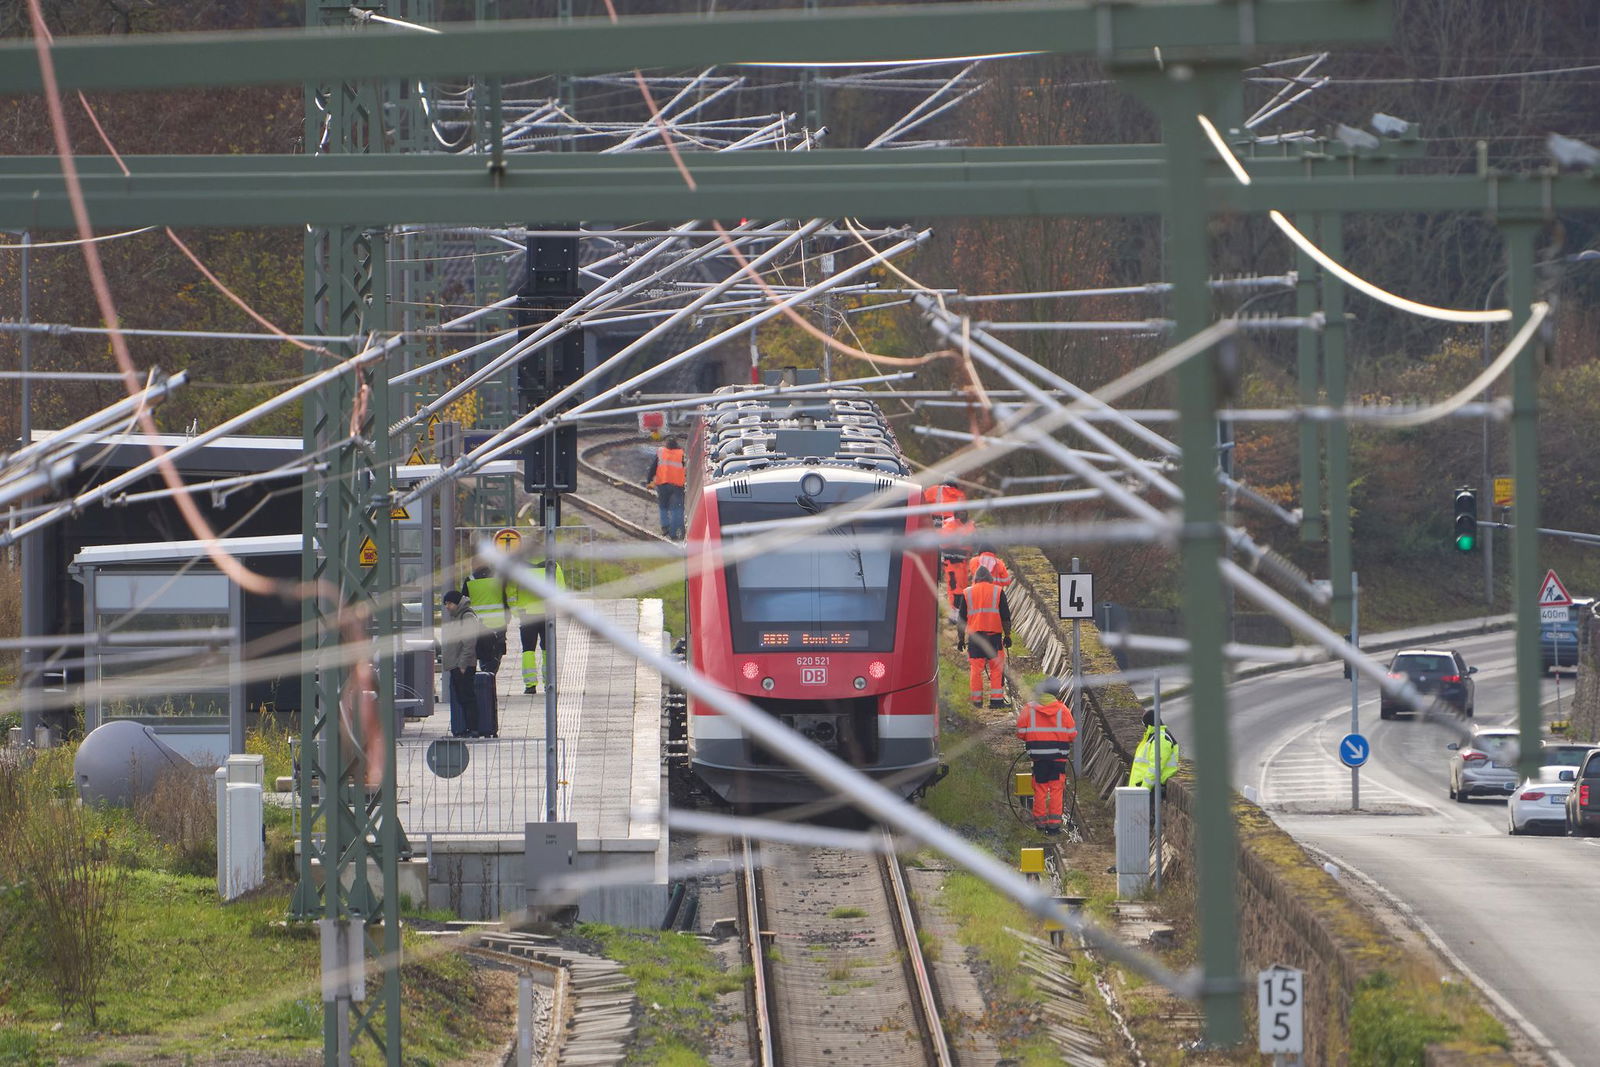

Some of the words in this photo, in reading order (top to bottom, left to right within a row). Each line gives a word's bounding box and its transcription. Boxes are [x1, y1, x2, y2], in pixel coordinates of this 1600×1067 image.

[1069, 579, 1084, 612] 4
[1541, 610, 1567, 619] 400m
[802, 633, 828, 644] Bonn
[796, 656, 813, 665] 620
[815, 656, 830, 665] 521
[803, 669, 826, 683] DB
[1263, 978, 1297, 1007] 15
[1272, 1012, 1291, 1041] 5
